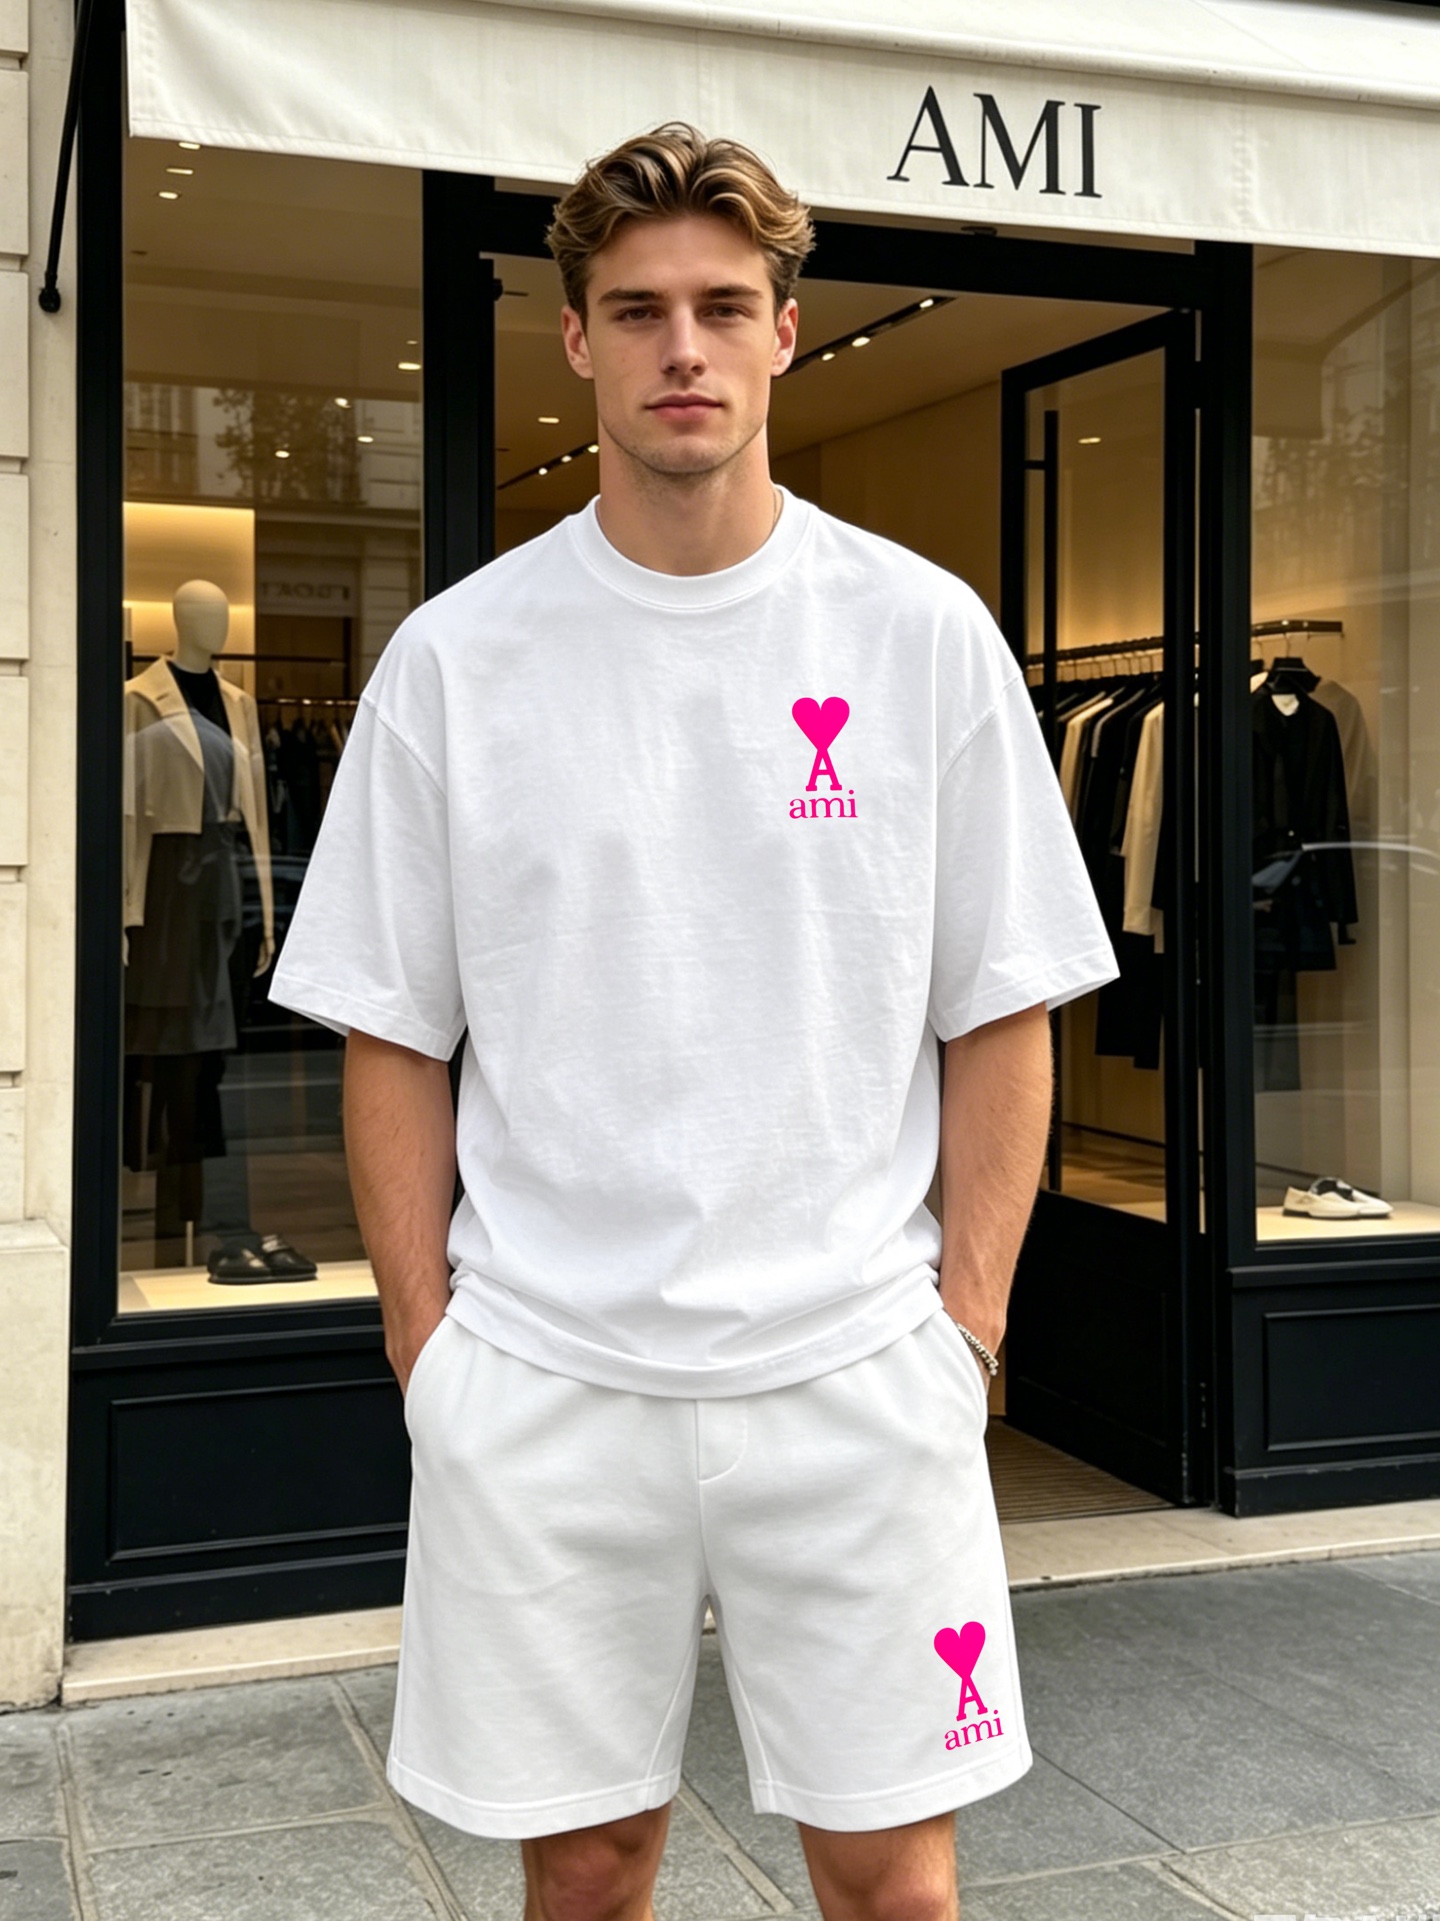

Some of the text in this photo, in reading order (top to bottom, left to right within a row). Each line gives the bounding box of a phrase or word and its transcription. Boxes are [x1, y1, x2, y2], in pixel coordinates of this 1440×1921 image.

[886, 85, 1103, 199] AMI
[789, 789, 858, 819] ami
[944, 1709, 1004, 1750] ami
